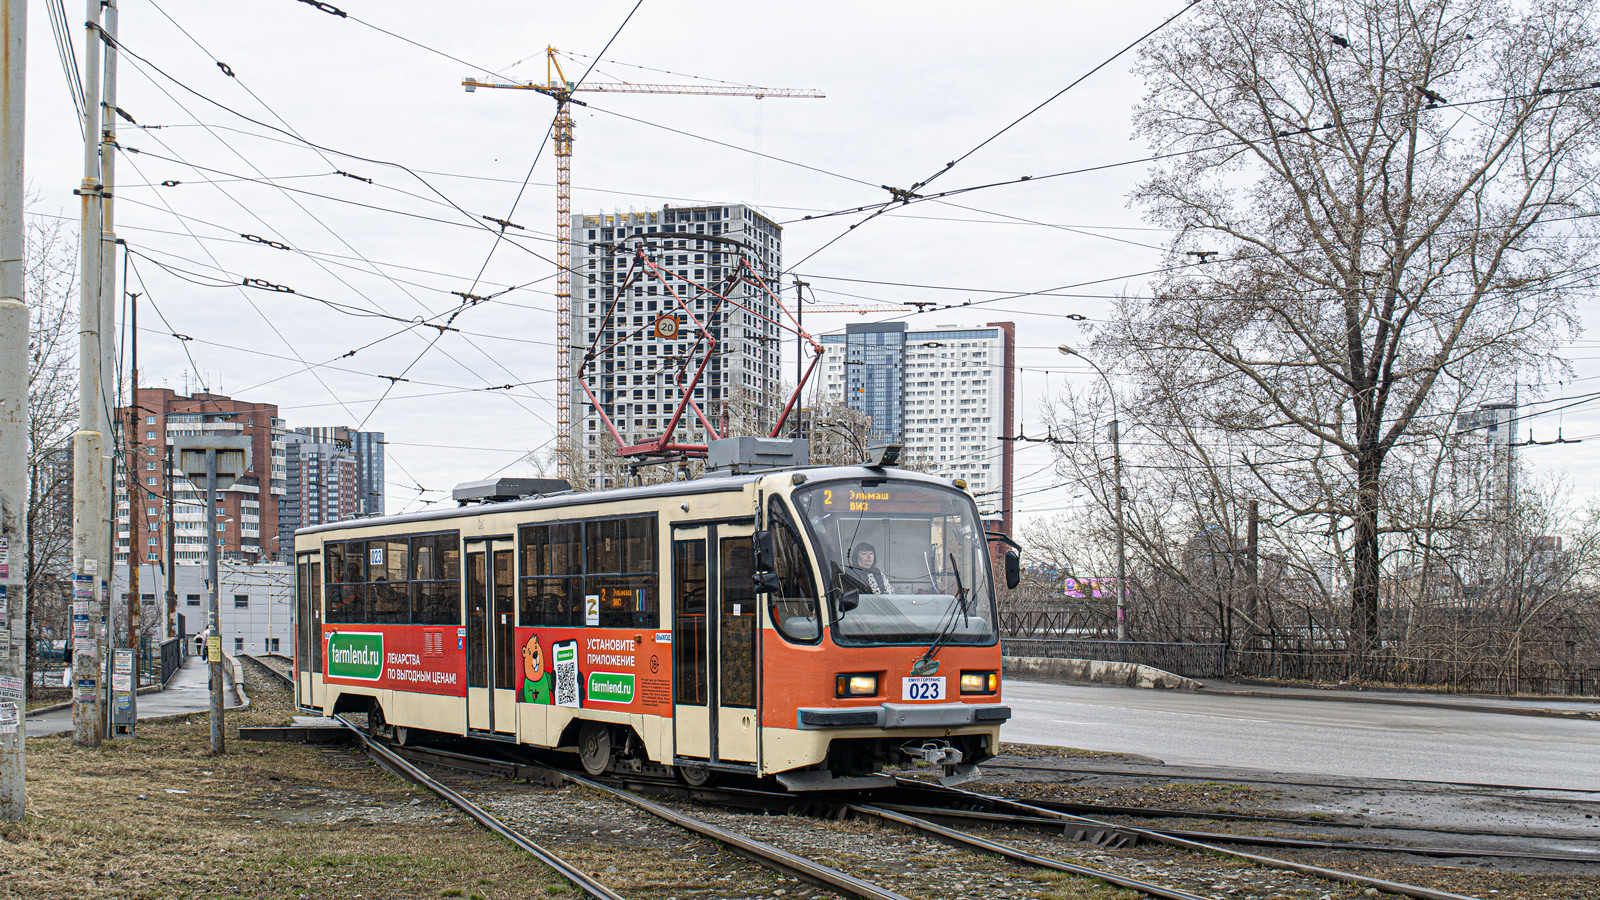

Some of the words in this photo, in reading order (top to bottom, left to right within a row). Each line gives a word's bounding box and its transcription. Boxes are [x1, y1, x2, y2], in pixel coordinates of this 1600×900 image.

[661, 322, 673, 332] 20
[824, 489, 833, 504] 2
[849, 490, 889, 500] Эльмаш
[849, 501, 868, 511] ВИЗ
[371, 550, 382, 564] 023
[601, 588, 606, 602] 2
[587, 638, 635, 652] УСТАНОВИТЕ
[656, 634, 671, 642] ВЫХОД
[331, 643, 379, 666] farmlend.ru
[387, 653, 421, 666] ЛЕКАРСТВА
[587, 654, 636, 667] ПРИЛОЖЕНИЕ
[387, 668, 397, 680] ПО
[397, 669, 432, 683] ВЫГОДНЫМ
[432, 672, 457, 685] ЦЕНАМ!
[591, 679, 632, 695] farmlend.ru
[909, 683, 939, 699] 023
